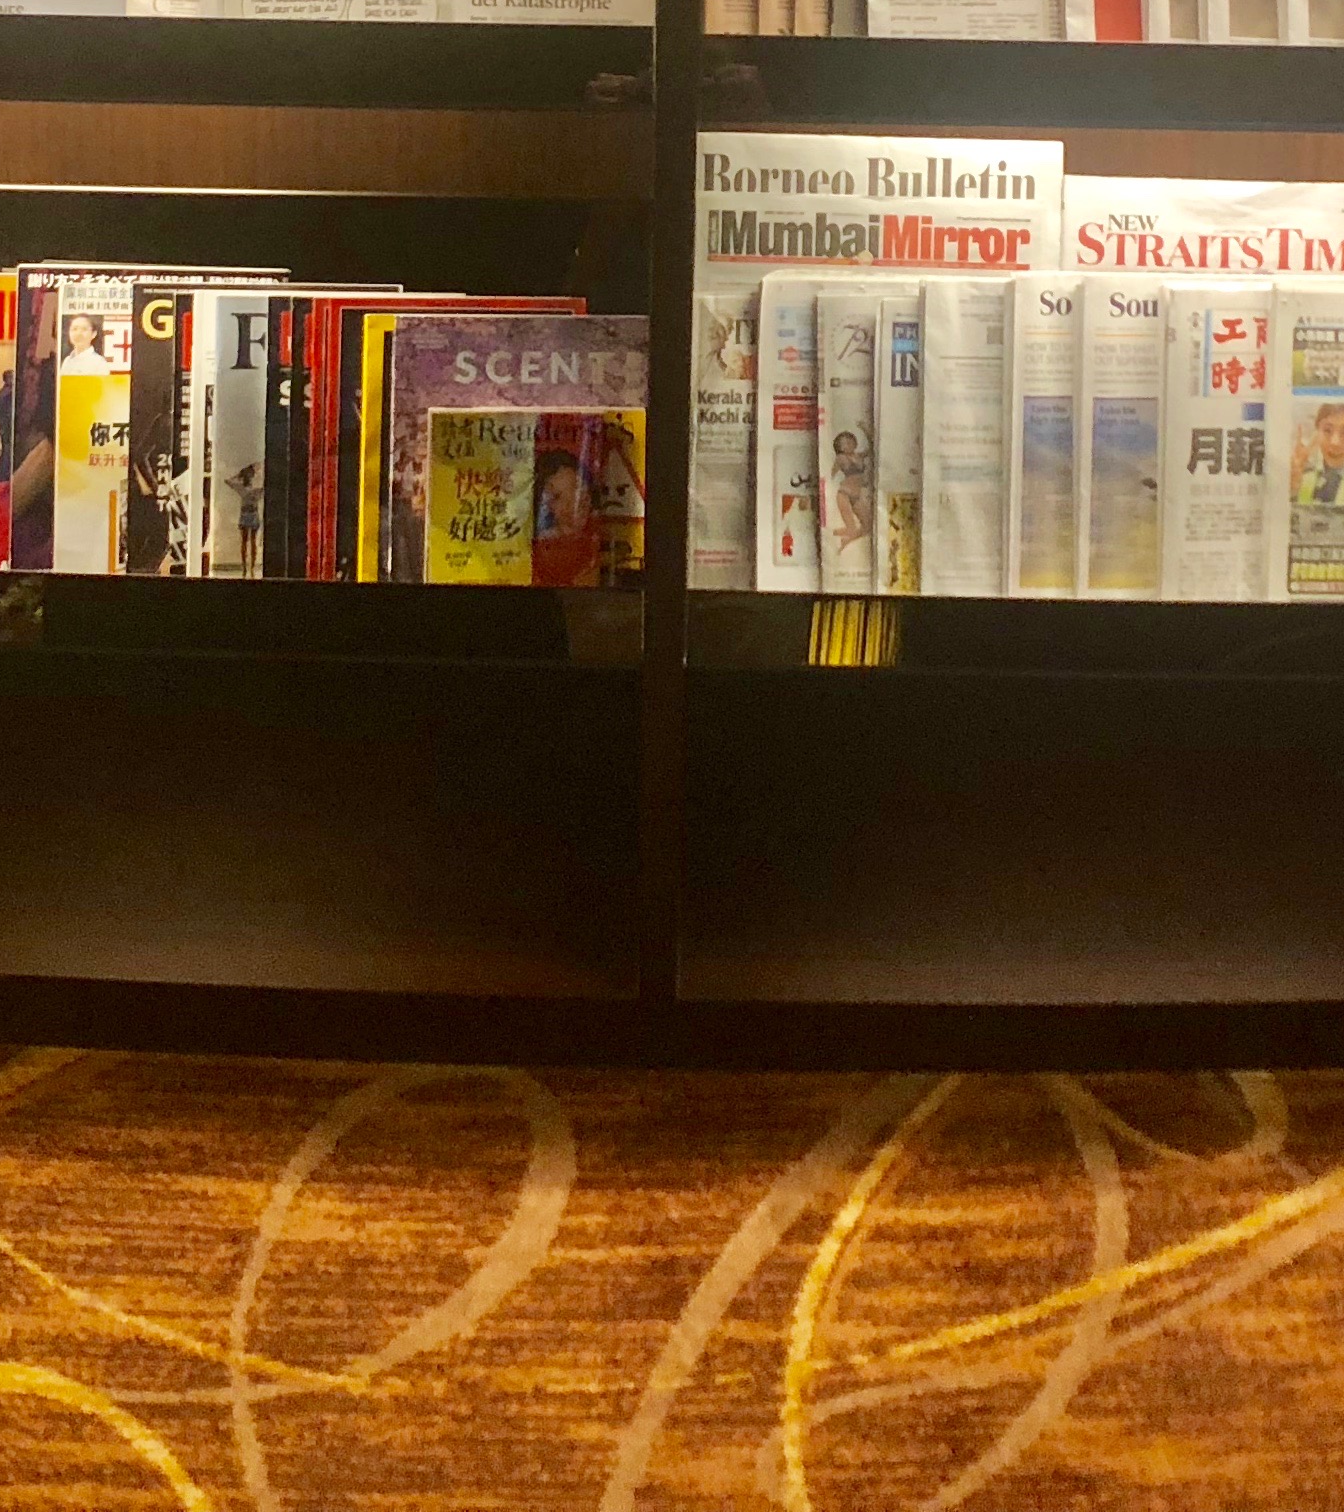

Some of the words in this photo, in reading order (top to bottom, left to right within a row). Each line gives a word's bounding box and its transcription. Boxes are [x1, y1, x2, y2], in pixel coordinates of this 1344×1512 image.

[703, 152, 856, 196] Borneo
[866, 156, 1036, 201] Bulletin
[1106, 214, 1159, 233] NEW
[1076, 222, 1265, 271] STRAITS
[1039, 289, 1073, 317] So
[1109, 291, 1159, 318] Sou
[141, 299, 174, 339] G
[697, 389, 744, 406] Kerala
[697, 408, 740, 426] Kochi
